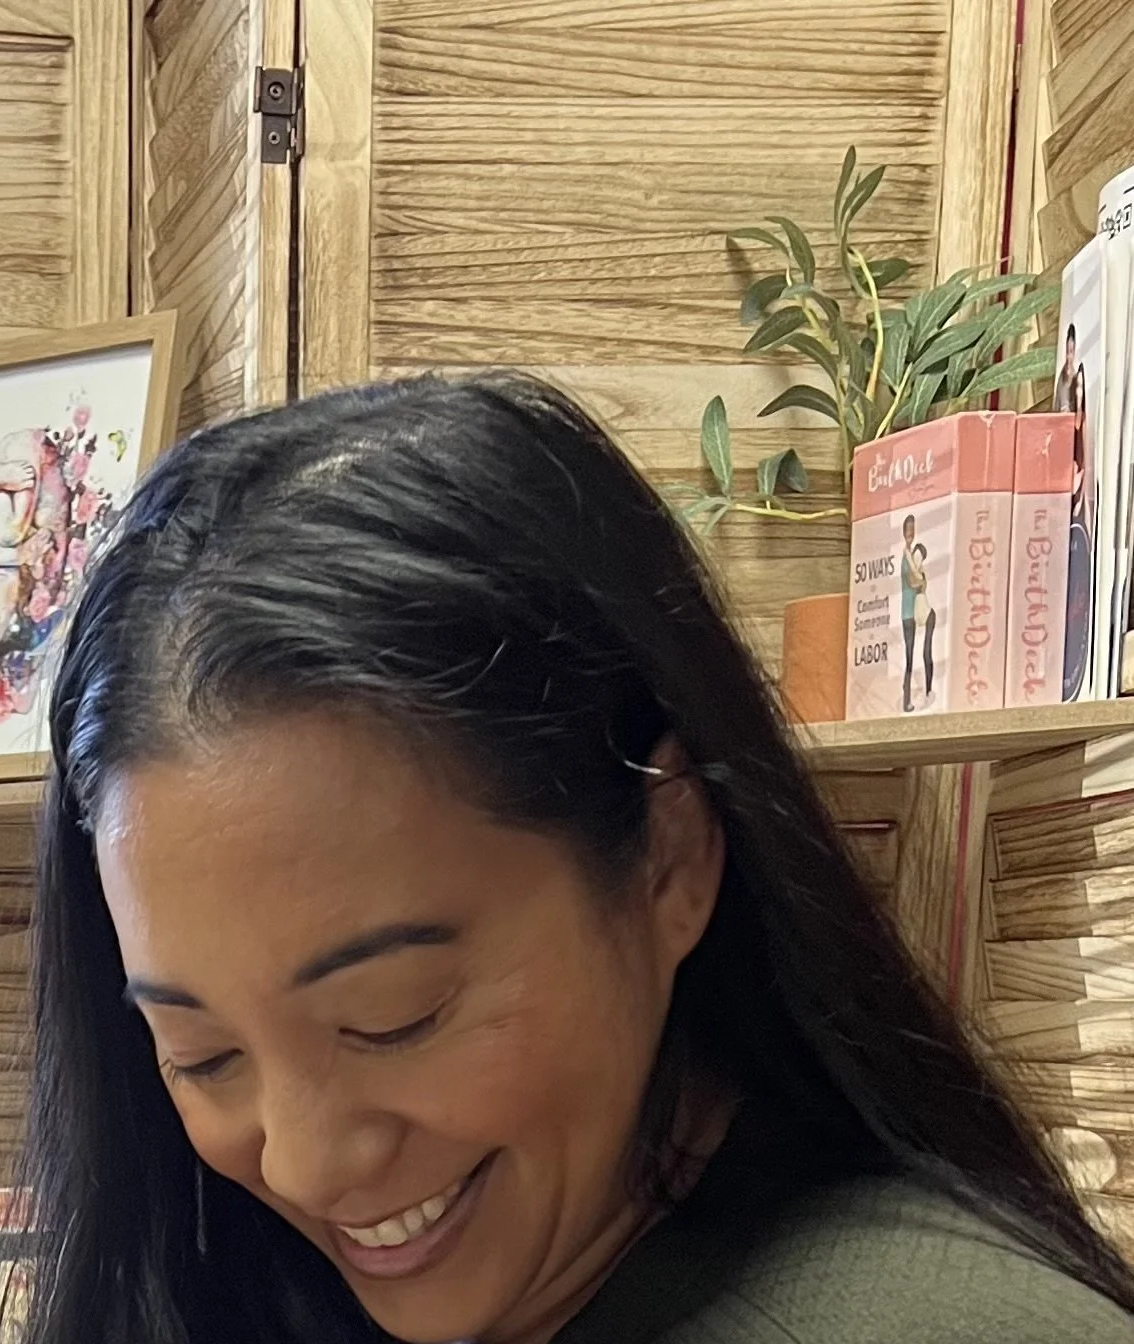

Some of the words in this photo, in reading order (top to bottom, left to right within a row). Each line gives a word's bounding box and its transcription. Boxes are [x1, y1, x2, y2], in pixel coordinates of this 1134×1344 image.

[854, 562, 867, 584] 50
[868, 555, 895, 580] WAYS
[854, 642, 888, 667] LABOR
